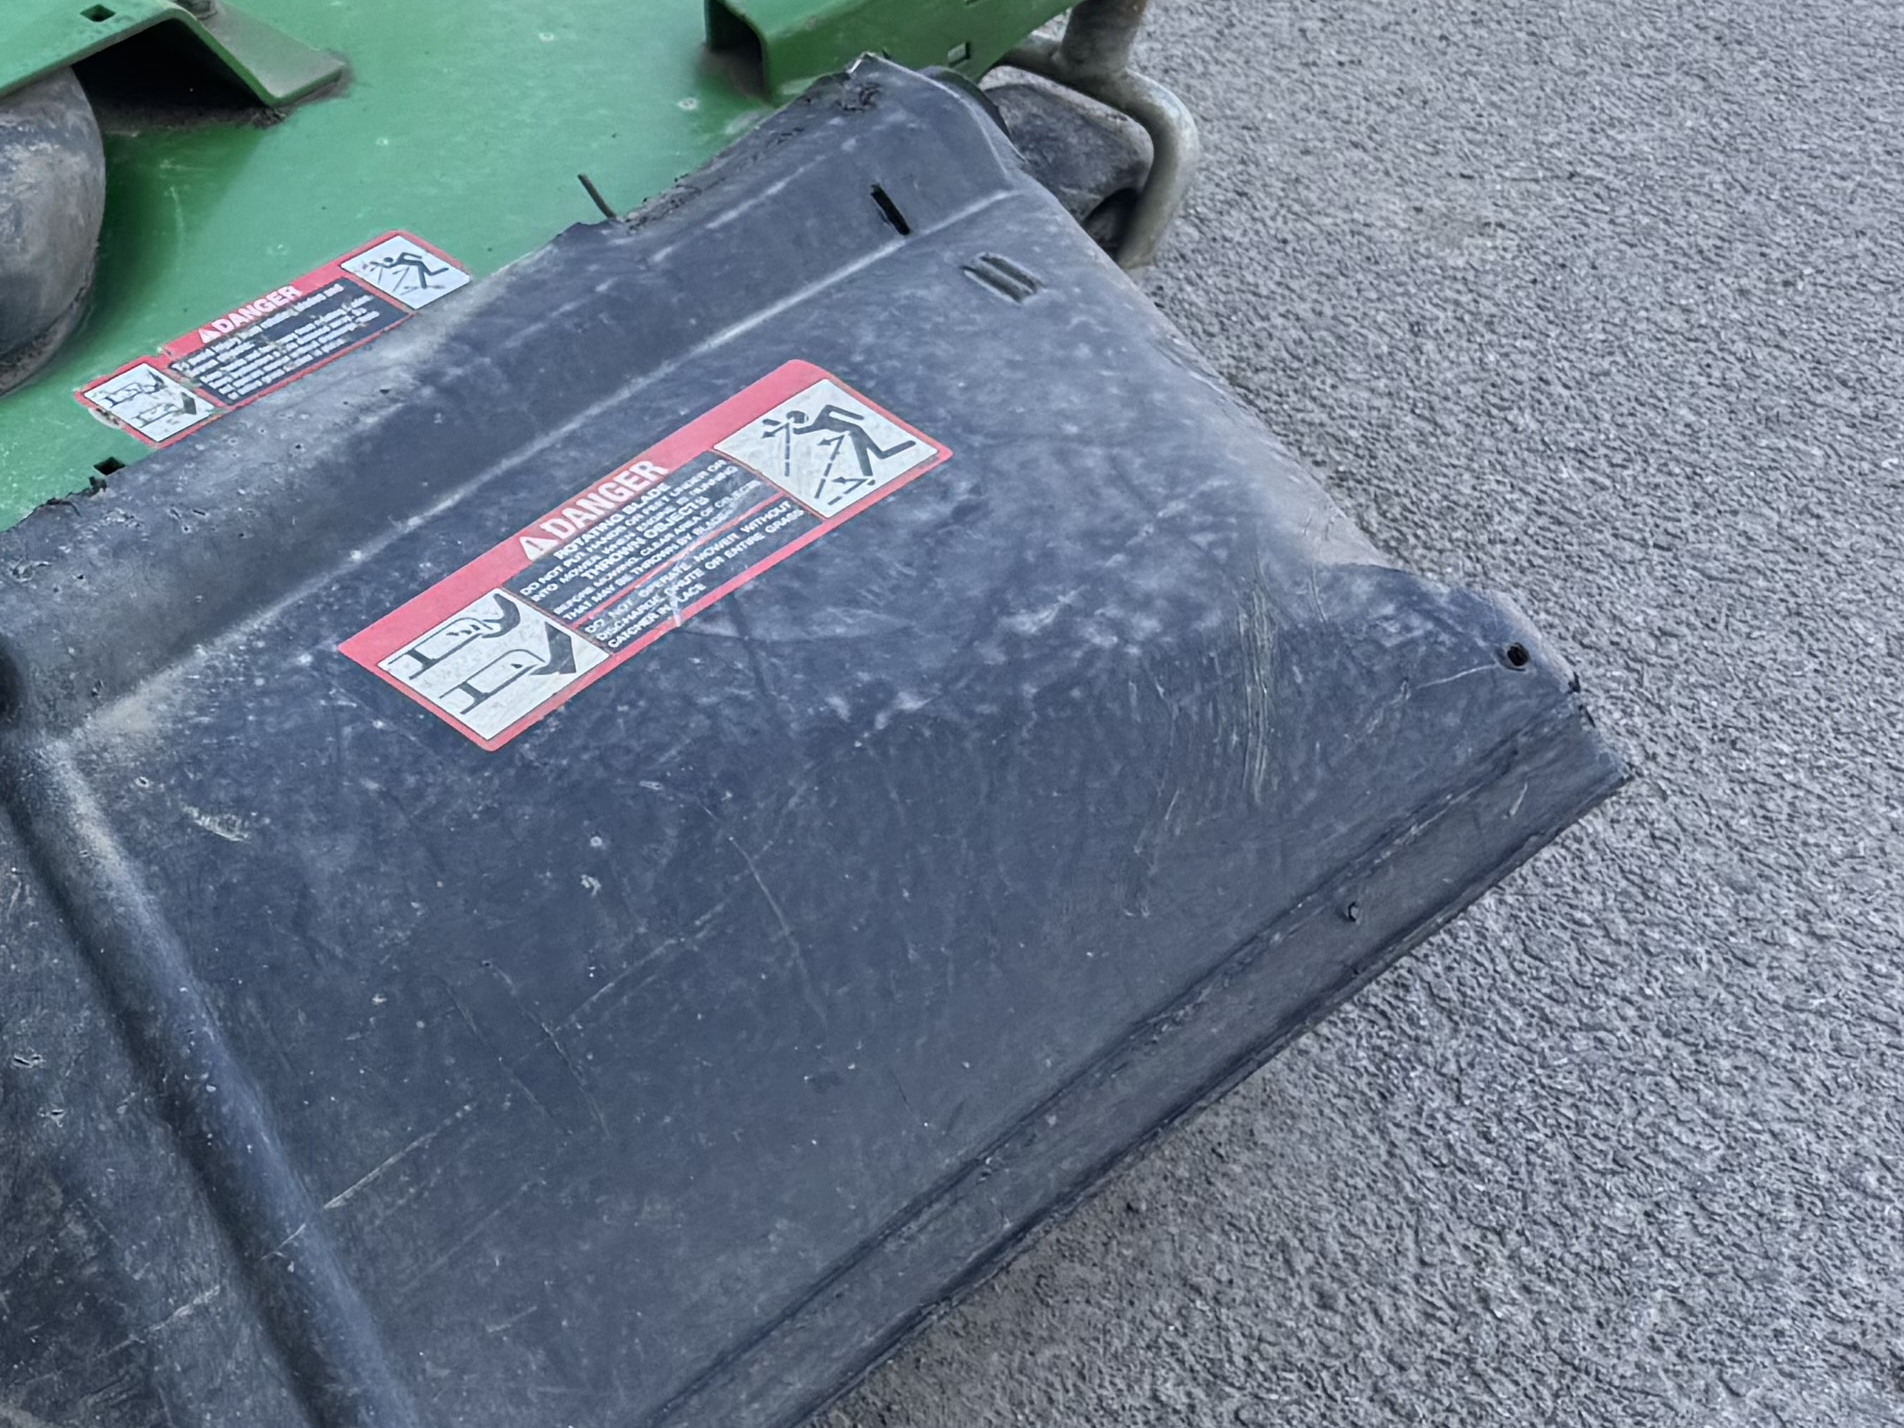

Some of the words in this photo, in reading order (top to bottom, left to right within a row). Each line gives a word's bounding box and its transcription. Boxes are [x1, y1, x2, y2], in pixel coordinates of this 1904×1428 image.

[212, 286, 302, 333] DANGER
[518, 580, 542, 596] DO
[536, 565, 566, 584] NOT
[560, 549, 588, 567] PUT
[583, 523, 628, 552] HANDS
[622, 512, 645, 527] OR
[640, 495, 672, 515] FEET
[667, 469, 710, 497] UNDER
[704, 458, 727, 473] OR
[540, 461, 669, 539] DANGER
[552, 511, 626, 559] ROTATING
[621, 481, 672, 514] BLADE
[579, 536, 648, 580] THROWN
[640, 494, 711, 540] OBJECTS
[638, 531, 677, 557] CLEAR
[672, 515, 703, 535] AREA
[698, 505, 717, 517] OF
[703, 556, 726, 570] OR
[722, 531, 766, 559] ENTIRE
[763, 507, 806, 534] GRASS
[528, 581, 560, 602] INTO
[556, 553, 603, 583] MOWER
[599, 530, 637, 555] WHEN
[634, 504, 677, 532] ENGINE
[561, 599, 594, 621] THAT
[589, 584, 617, 602] MAY
[613, 573, 634, 586] BE
[629, 542, 681, 575] THROWN
[675, 533, 695, 545] BY
[582, 617, 608, 634] DO
[692, 531, 741, 563] MOWER
[739, 499, 793, 534] WITHOUT
[604, 612, 662, 648] CATCHER
[666, 581, 707, 608] LACE
